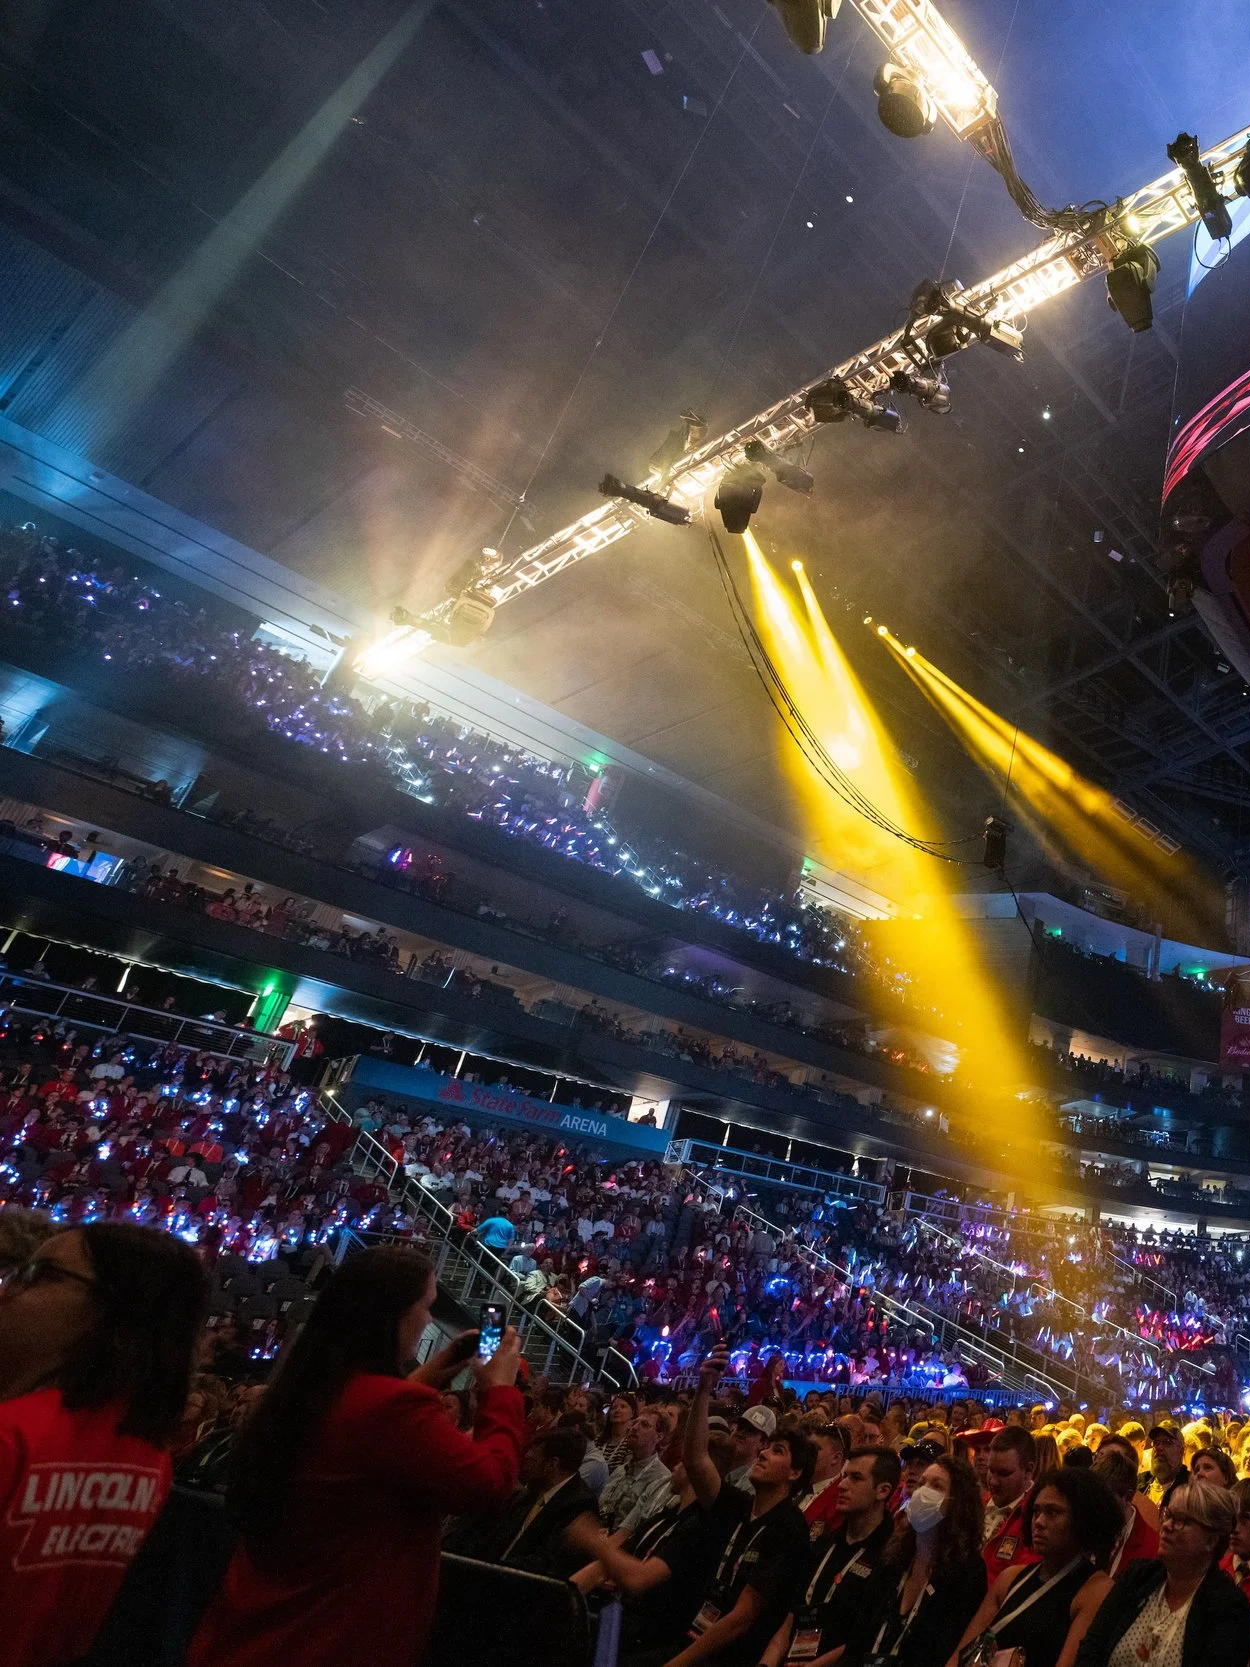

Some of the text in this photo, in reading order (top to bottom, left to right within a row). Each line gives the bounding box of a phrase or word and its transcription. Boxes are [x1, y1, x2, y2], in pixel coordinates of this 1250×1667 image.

[471, 1087, 608, 1137] State Farm ARENA
[20, 1471, 157, 1514] LINCOLN
